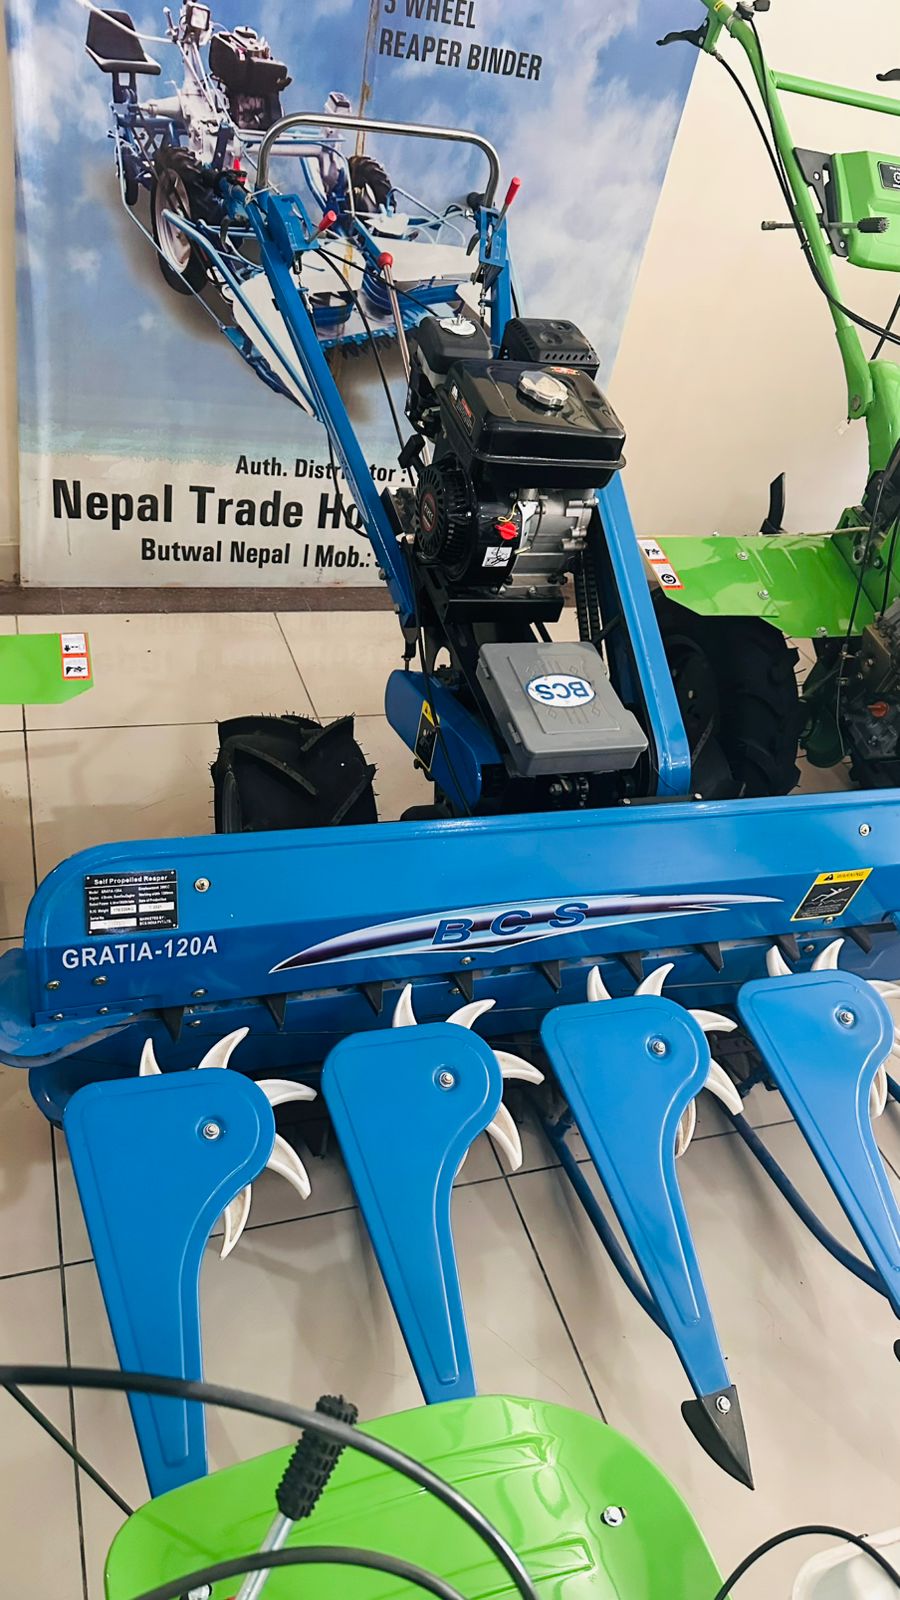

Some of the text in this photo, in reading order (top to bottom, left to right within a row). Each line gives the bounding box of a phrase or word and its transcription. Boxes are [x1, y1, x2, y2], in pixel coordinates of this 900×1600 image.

[405, 0, 476, 29] WHEEL
[378, 28, 543, 81] REAPER BINDER
[235, 455, 288, 477] Auth.
[52, 479, 173, 530] Nepal
[189, 485, 304, 528] Trade
[141, 538, 222, 563] Butwal
[230, 541, 290, 568] Nepal
[535, 681, 589, 700] BCS
[109, 877, 142, 885] Propelled
[62, 935, 218, 969] GRATIA-120A
